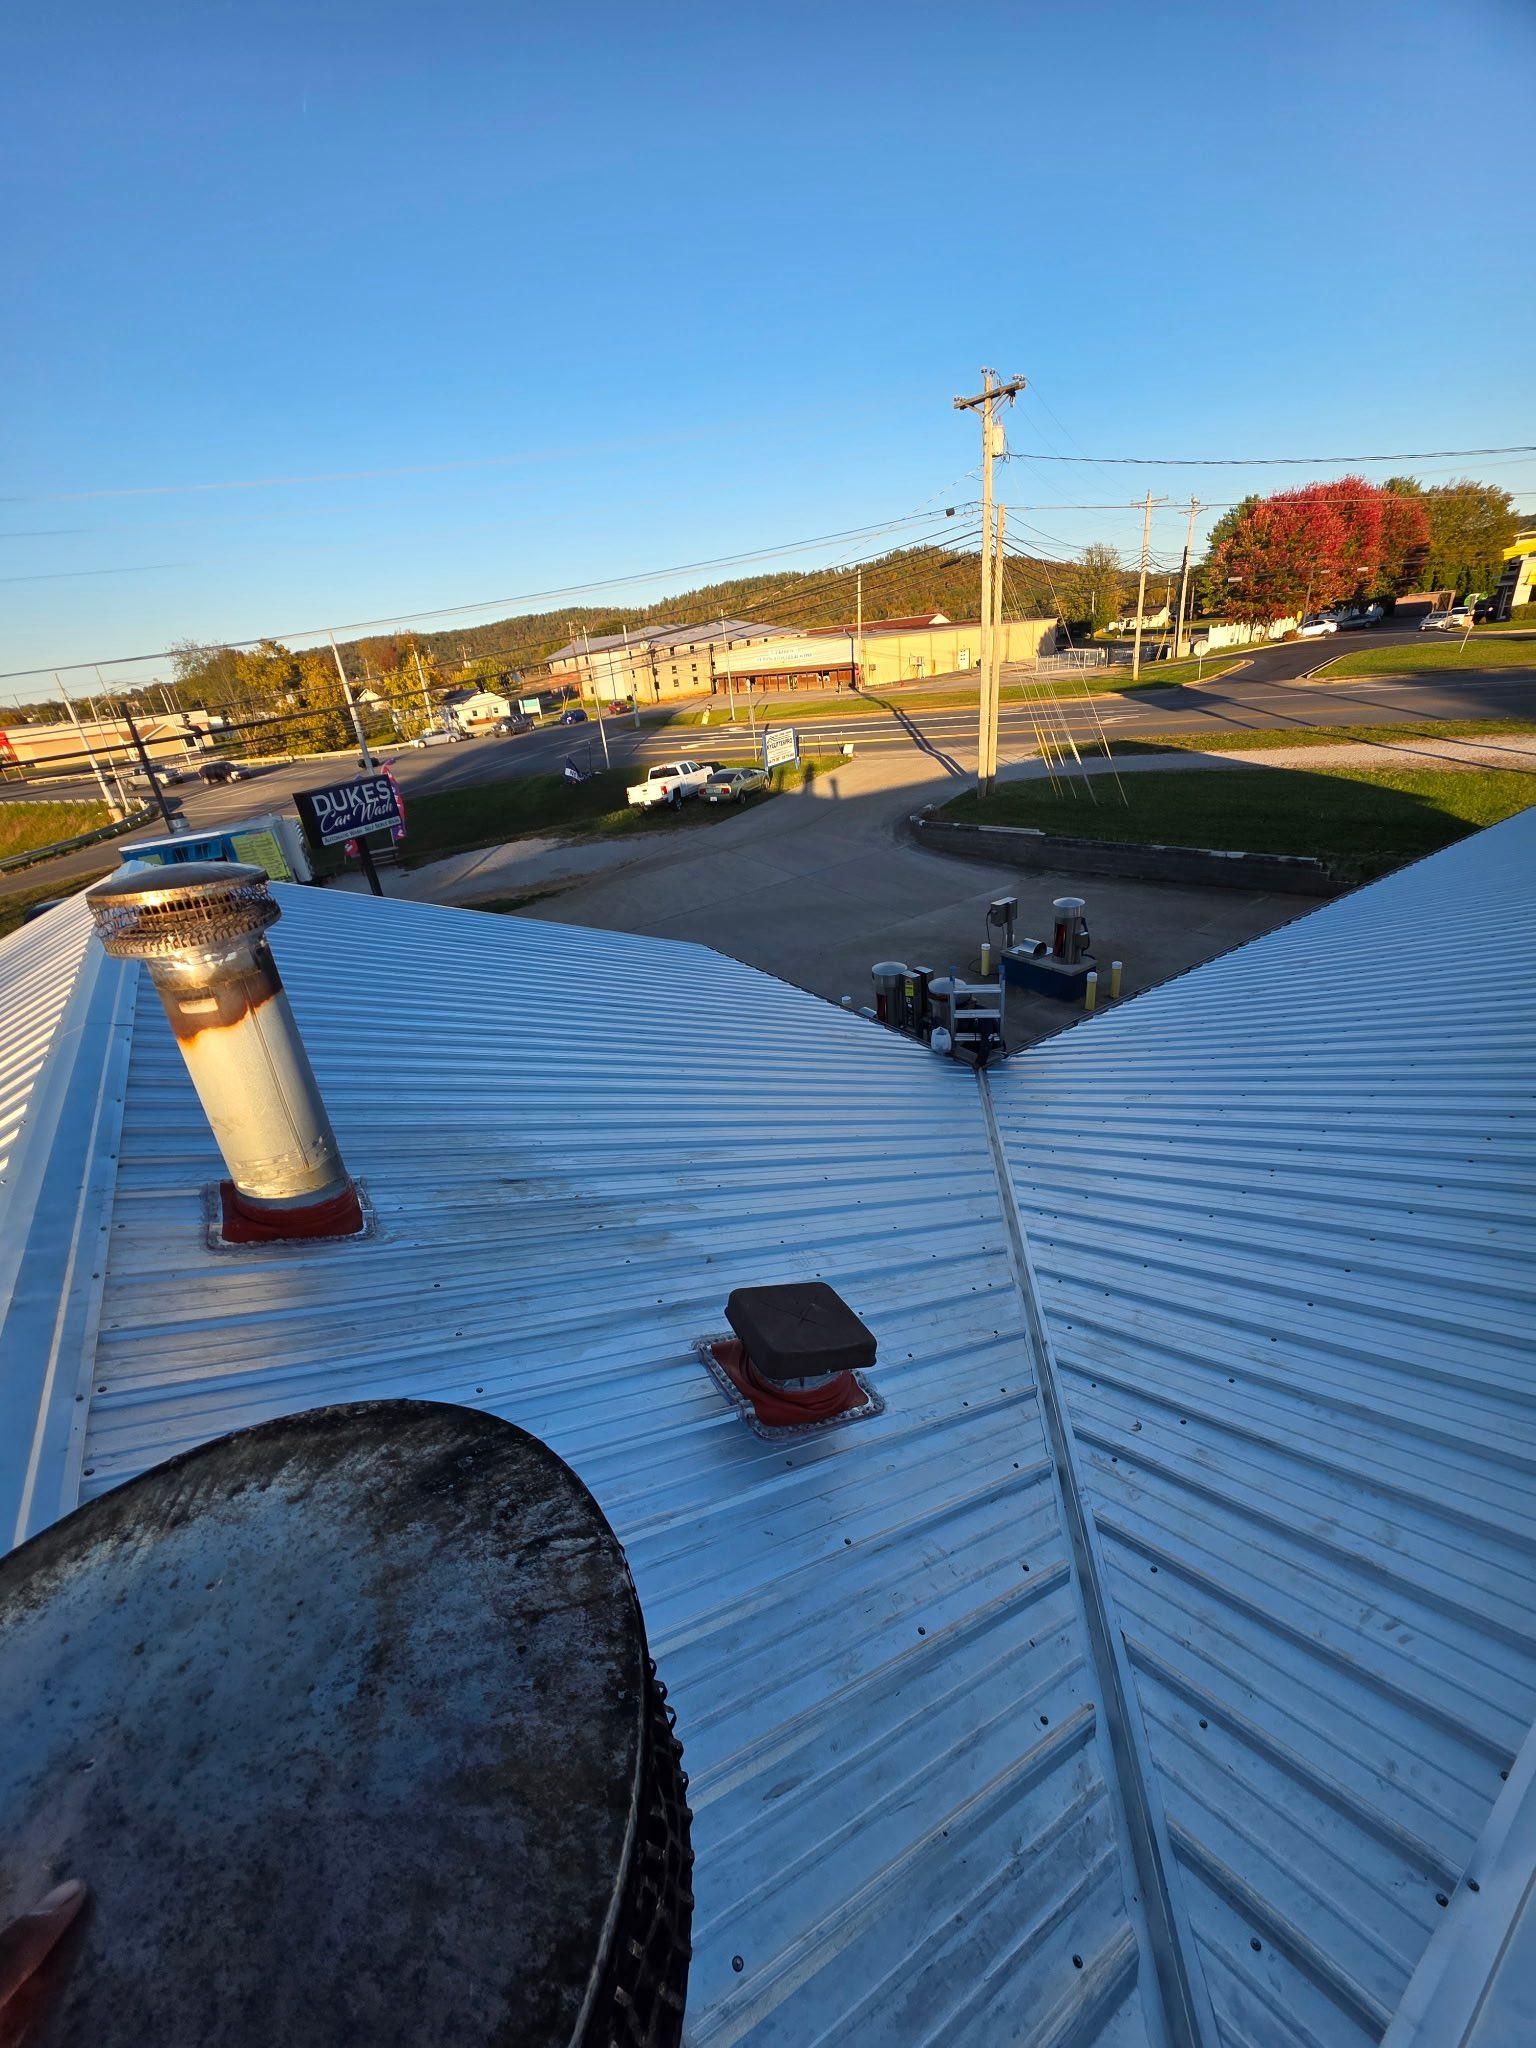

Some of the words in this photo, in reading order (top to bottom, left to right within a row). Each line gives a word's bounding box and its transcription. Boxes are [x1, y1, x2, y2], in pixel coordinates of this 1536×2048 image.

[311, 780, 391, 816] DUKES
[321, 808, 351, 833] Car
[353, 796, 393, 823] Wash
